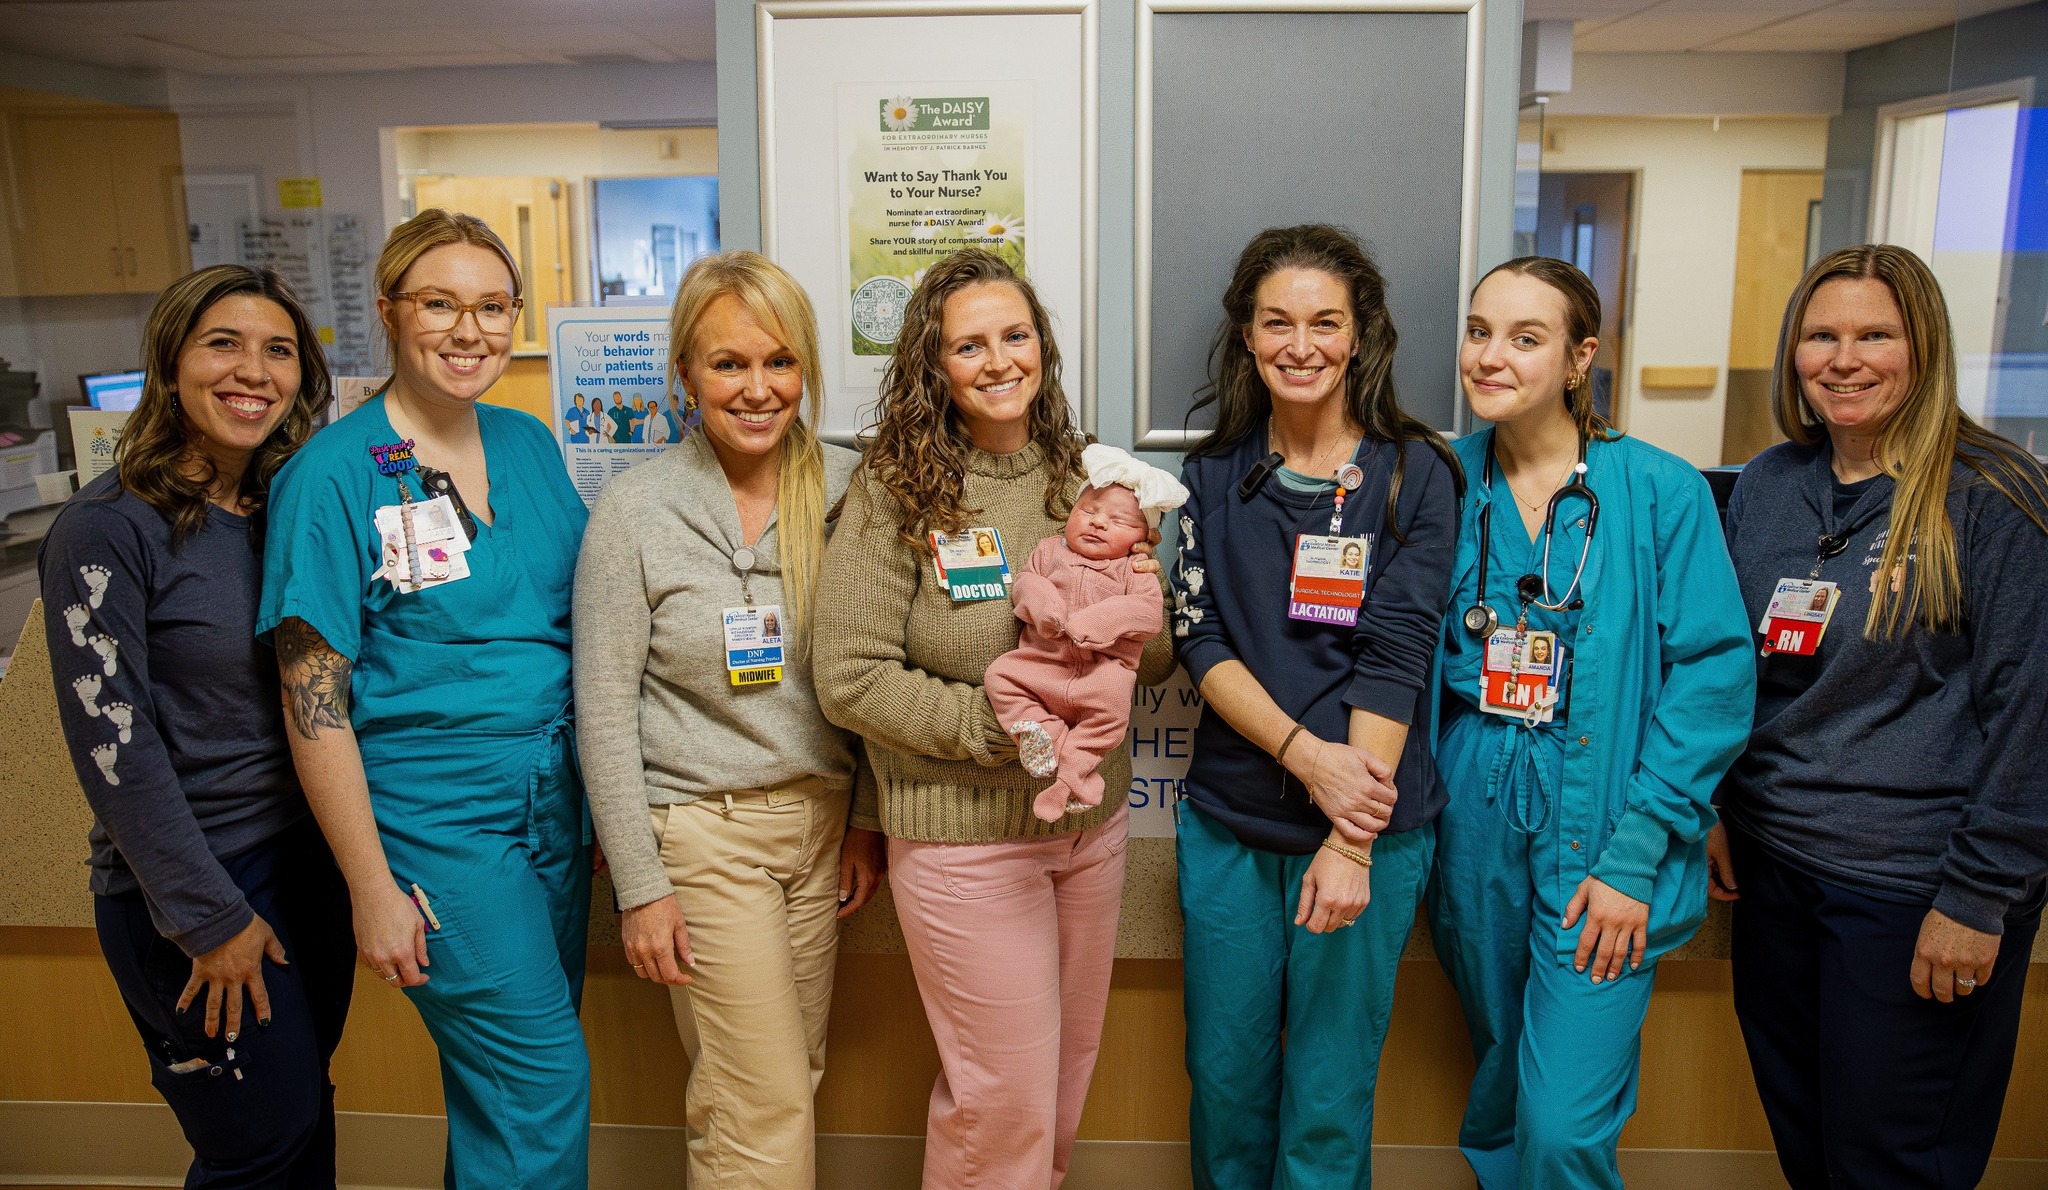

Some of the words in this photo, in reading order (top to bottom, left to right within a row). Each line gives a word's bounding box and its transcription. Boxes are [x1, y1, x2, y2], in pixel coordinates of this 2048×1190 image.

[920, 104, 940, 114] The
[942, 102, 984, 114] DAISY
[864, 172, 898, 182] Want
[901, 172, 913, 182] to
[916, 171, 938, 184] Say
[942, 170, 980, 181] Thank
[984, 169, 1007, 180] You
[890, 188, 902, 198] to
[906, 187, 934, 198] Your
[938, 186, 982, 198] Nurse?
[935, 208, 986, 216] extraordinary
[585, 331, 610, 342] Your
[614, 331, 650, 341] words
[575, 346, 600, 357] Your
[604, 346, 654, 356] behavior
[581, 360, 601, 371] Our
[606, 360, 653, 373] patients
[576, 376, 605, 386] team
[609, 375, 664, 385] members
[370, 443, 388, 454] Push
[389, 450, 410, 461] REAL
[379, 459, 413, 474] GOOD
[952, 583, 1004, 599] DOCTOR
[1321, 590, 1360, 598] TECHNOLOGIST
[1291, 602, 1355, 622] LACTATION
[1776, 630, 1805, 652] RN
[739, 669, 775, 683] MIDWIFE
